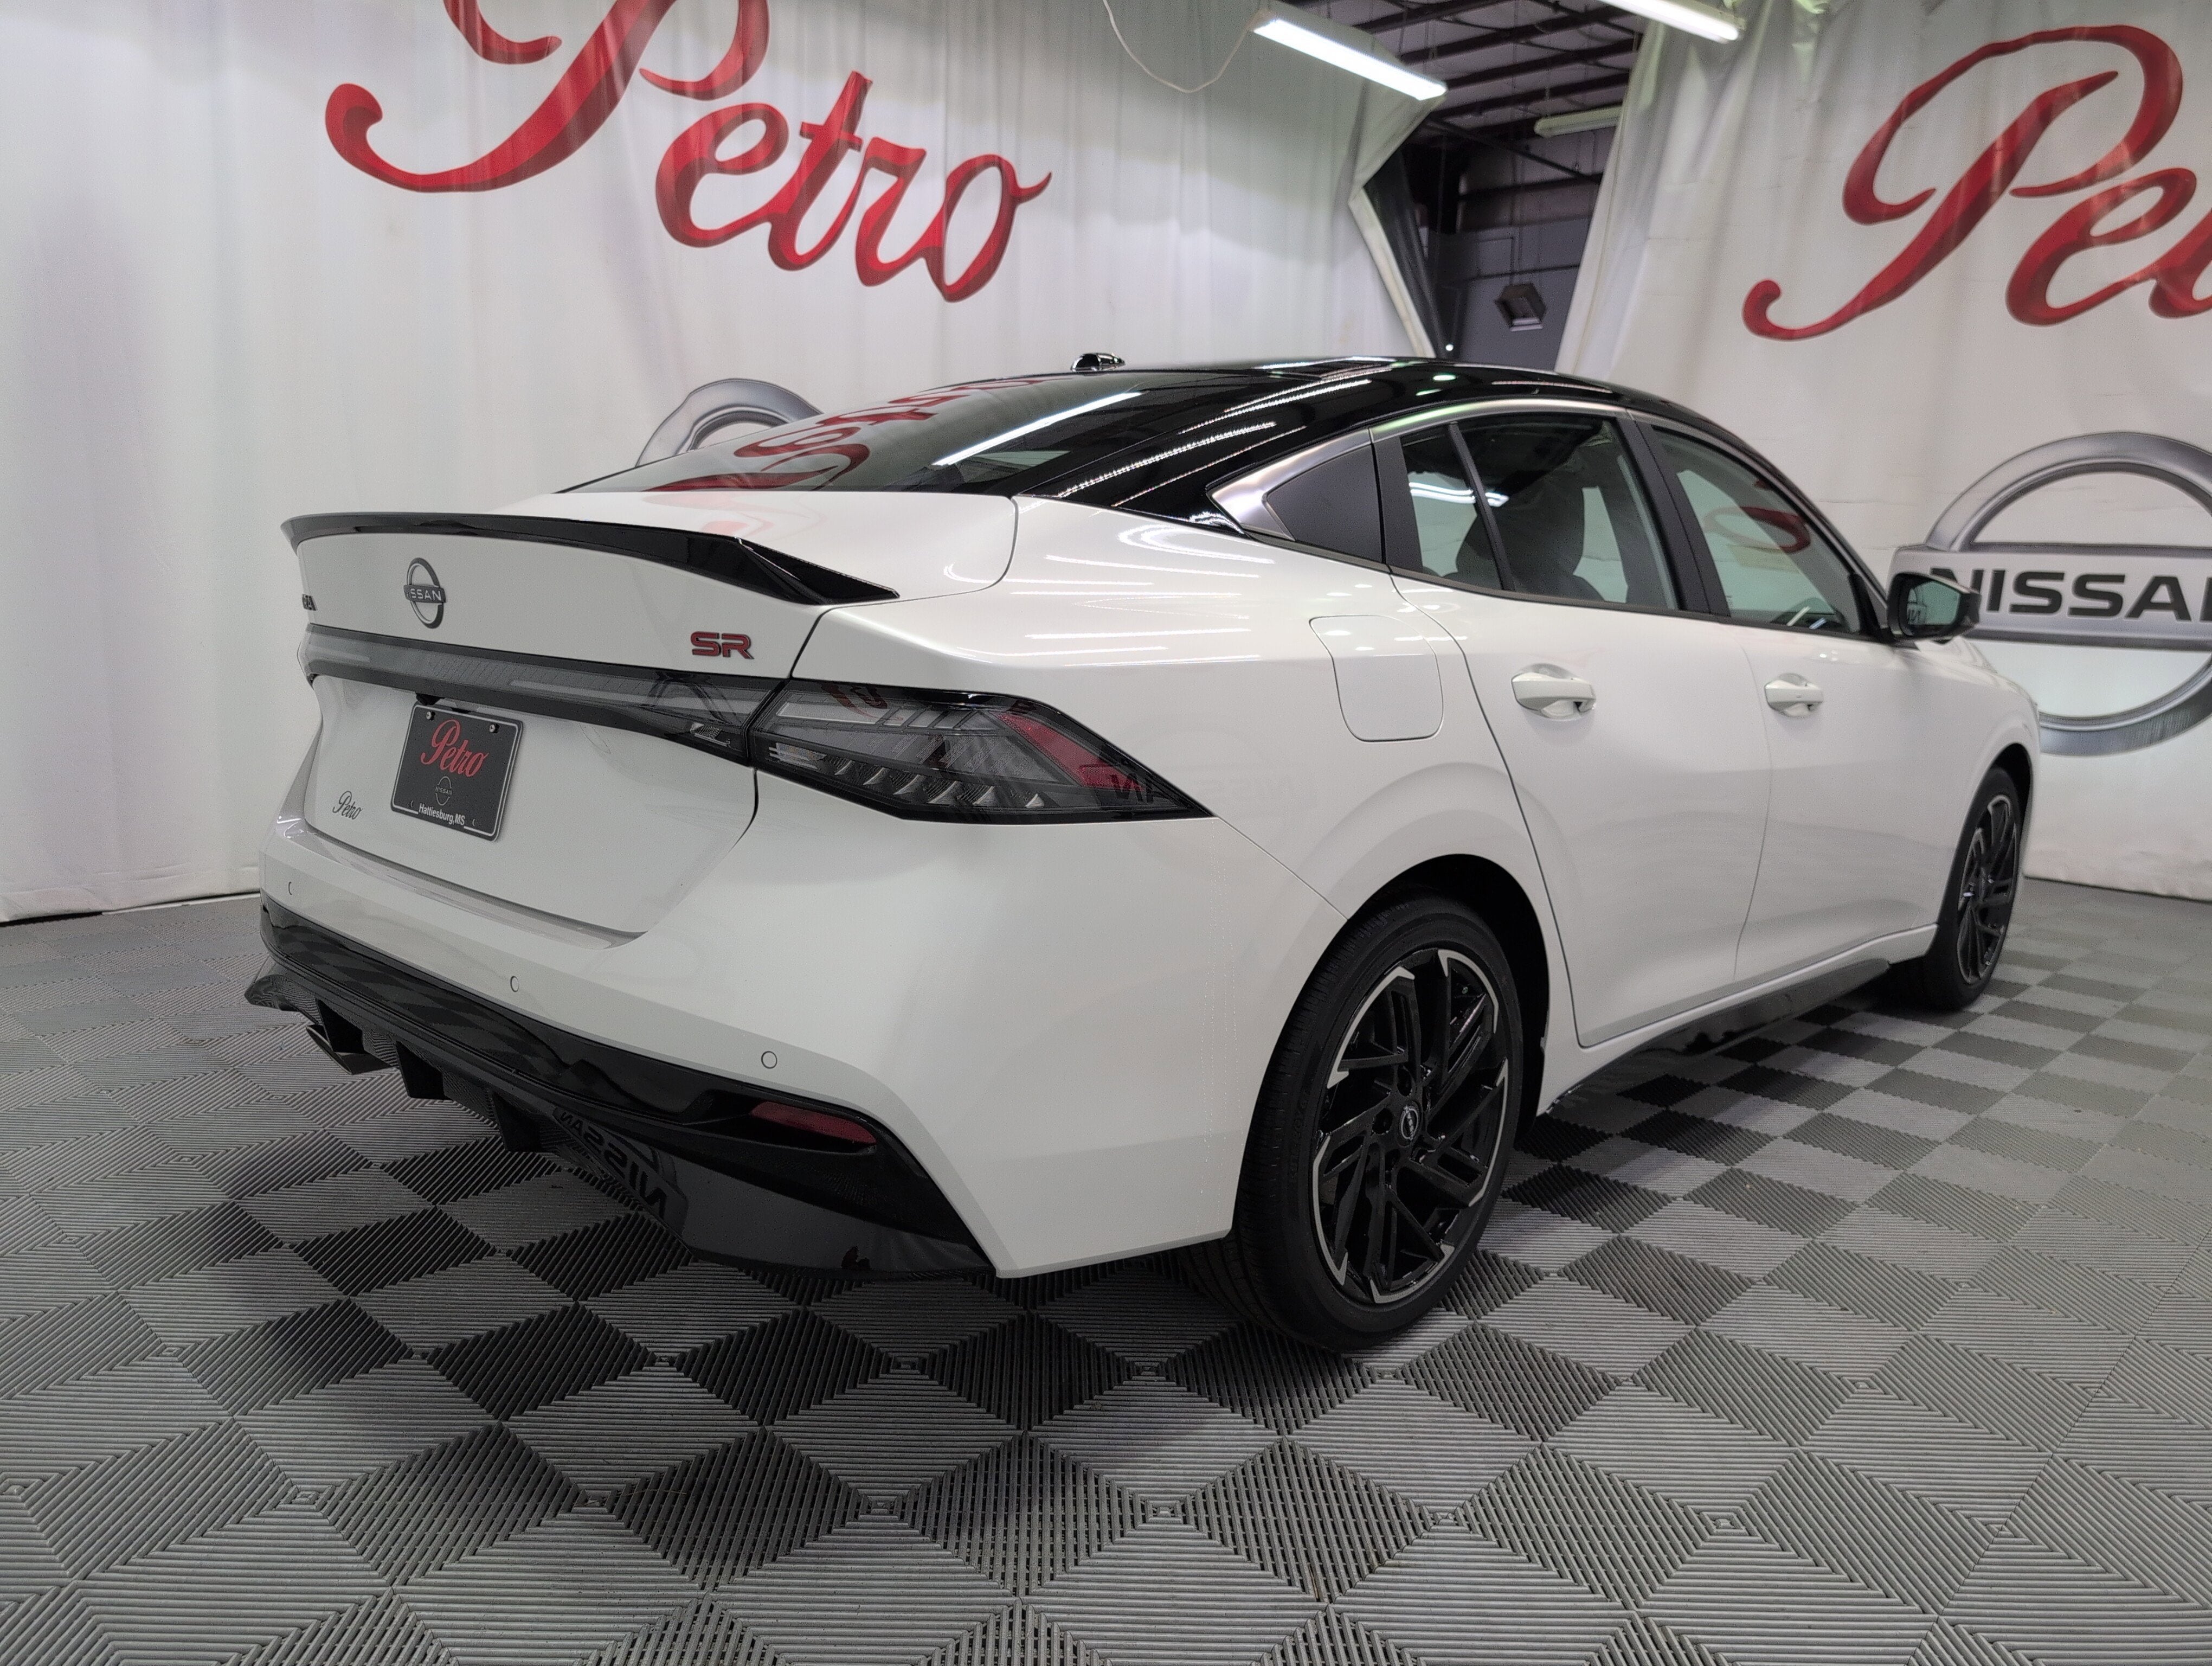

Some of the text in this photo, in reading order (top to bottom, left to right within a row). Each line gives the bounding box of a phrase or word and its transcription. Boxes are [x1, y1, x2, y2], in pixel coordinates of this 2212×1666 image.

[690, 631, 755, 659] SR
[420, 719, 489, 777] Petro
[332, 790, 363, 820] Petro
